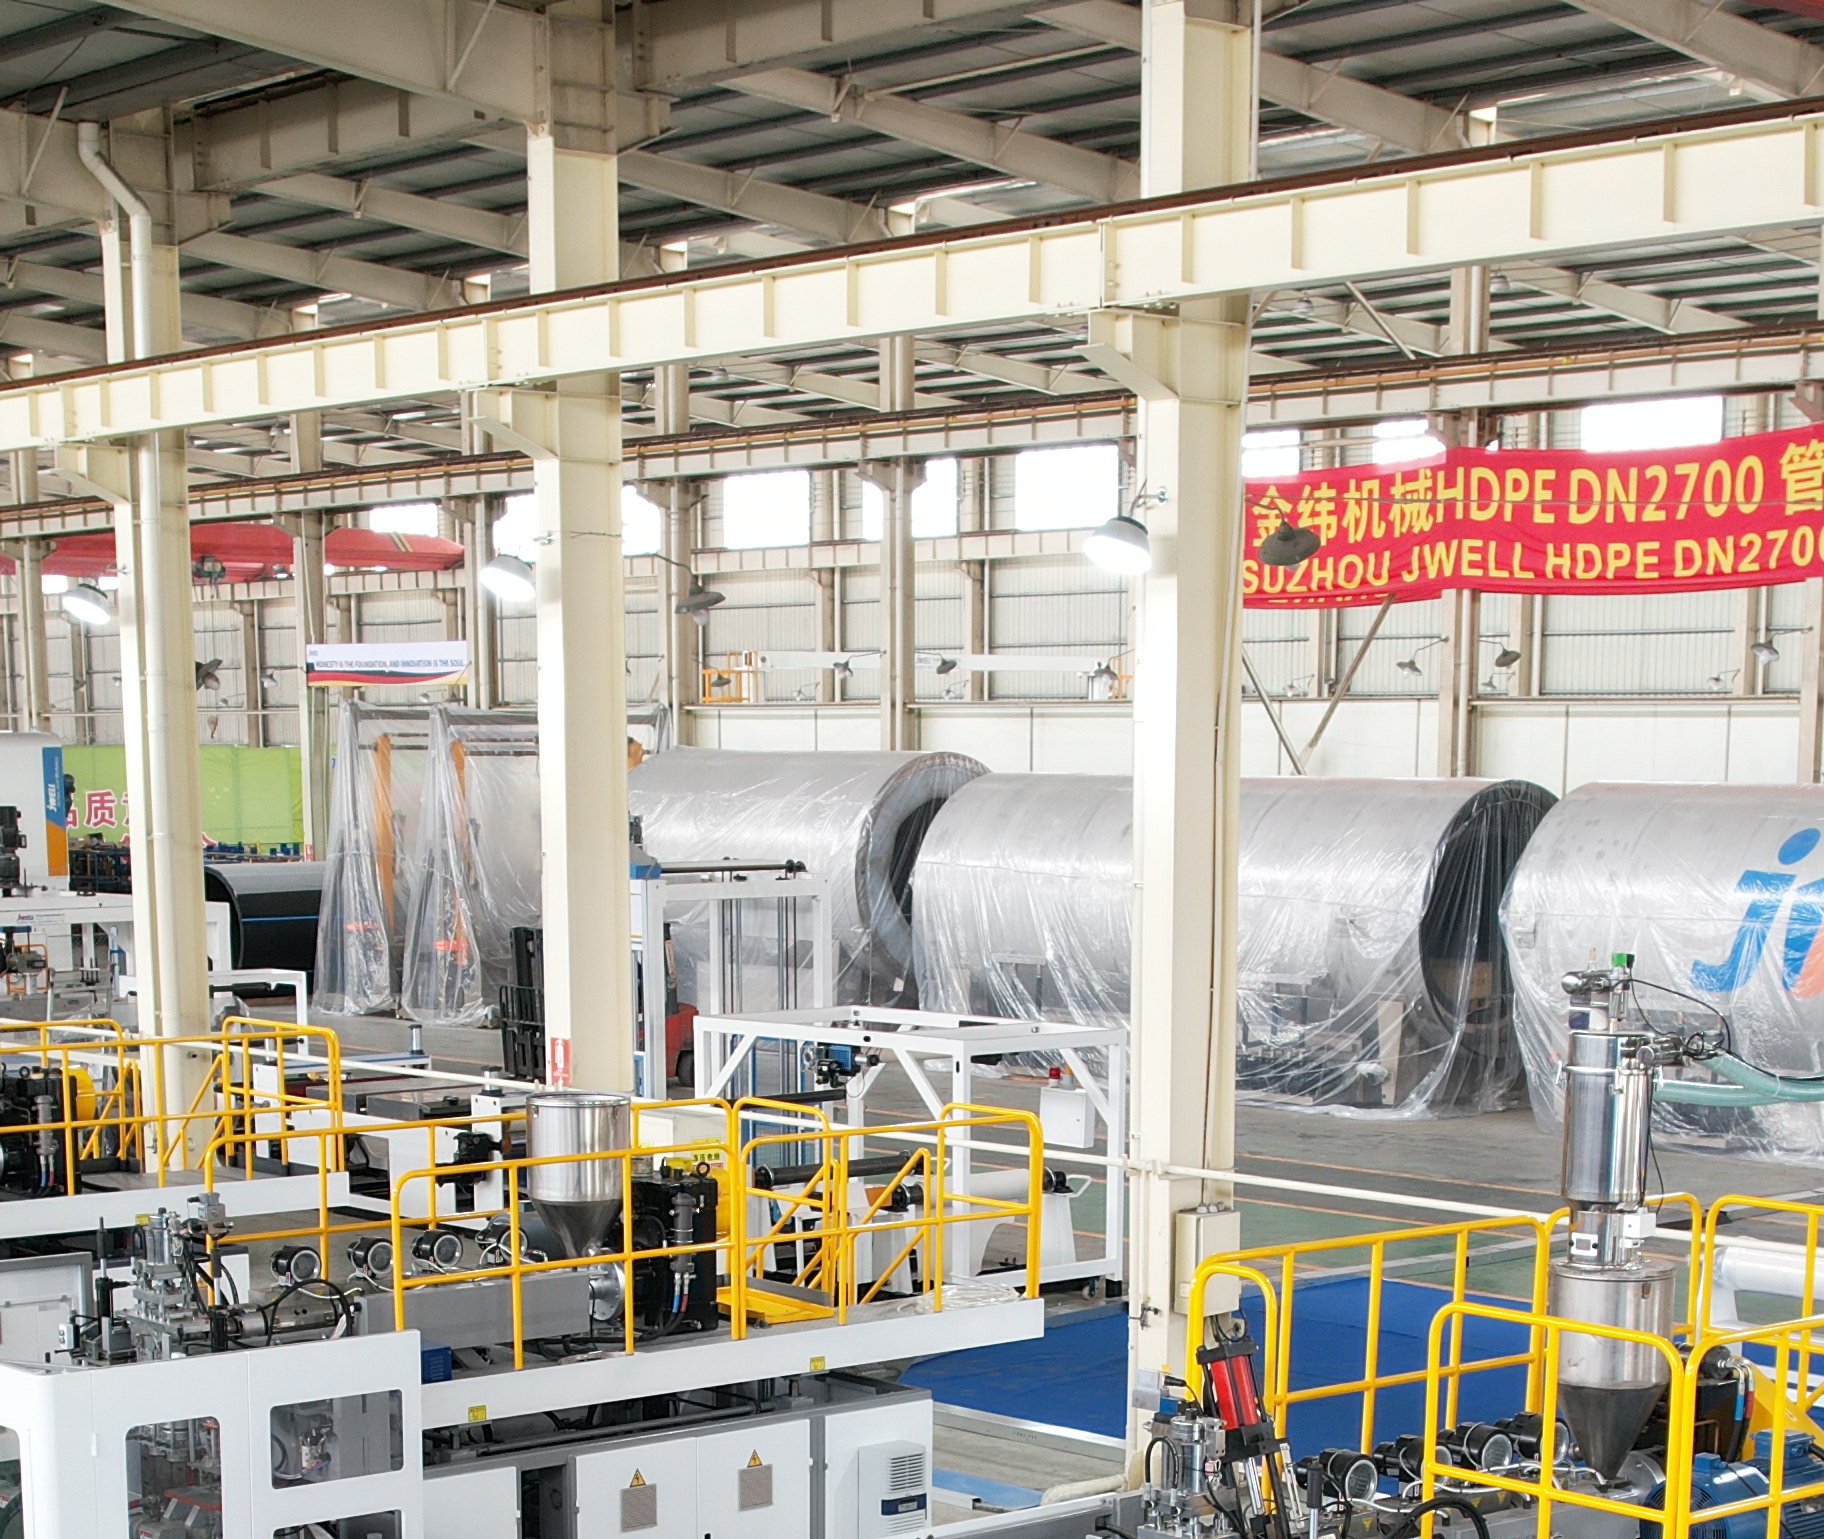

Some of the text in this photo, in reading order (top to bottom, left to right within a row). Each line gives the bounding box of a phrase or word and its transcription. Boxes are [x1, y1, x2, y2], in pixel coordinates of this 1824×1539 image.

[1569, 455, 1764, 524] DN2700
[1401, 539, 1536, 583] JWELL
[1545, 541, 1660, 581] HDPE
